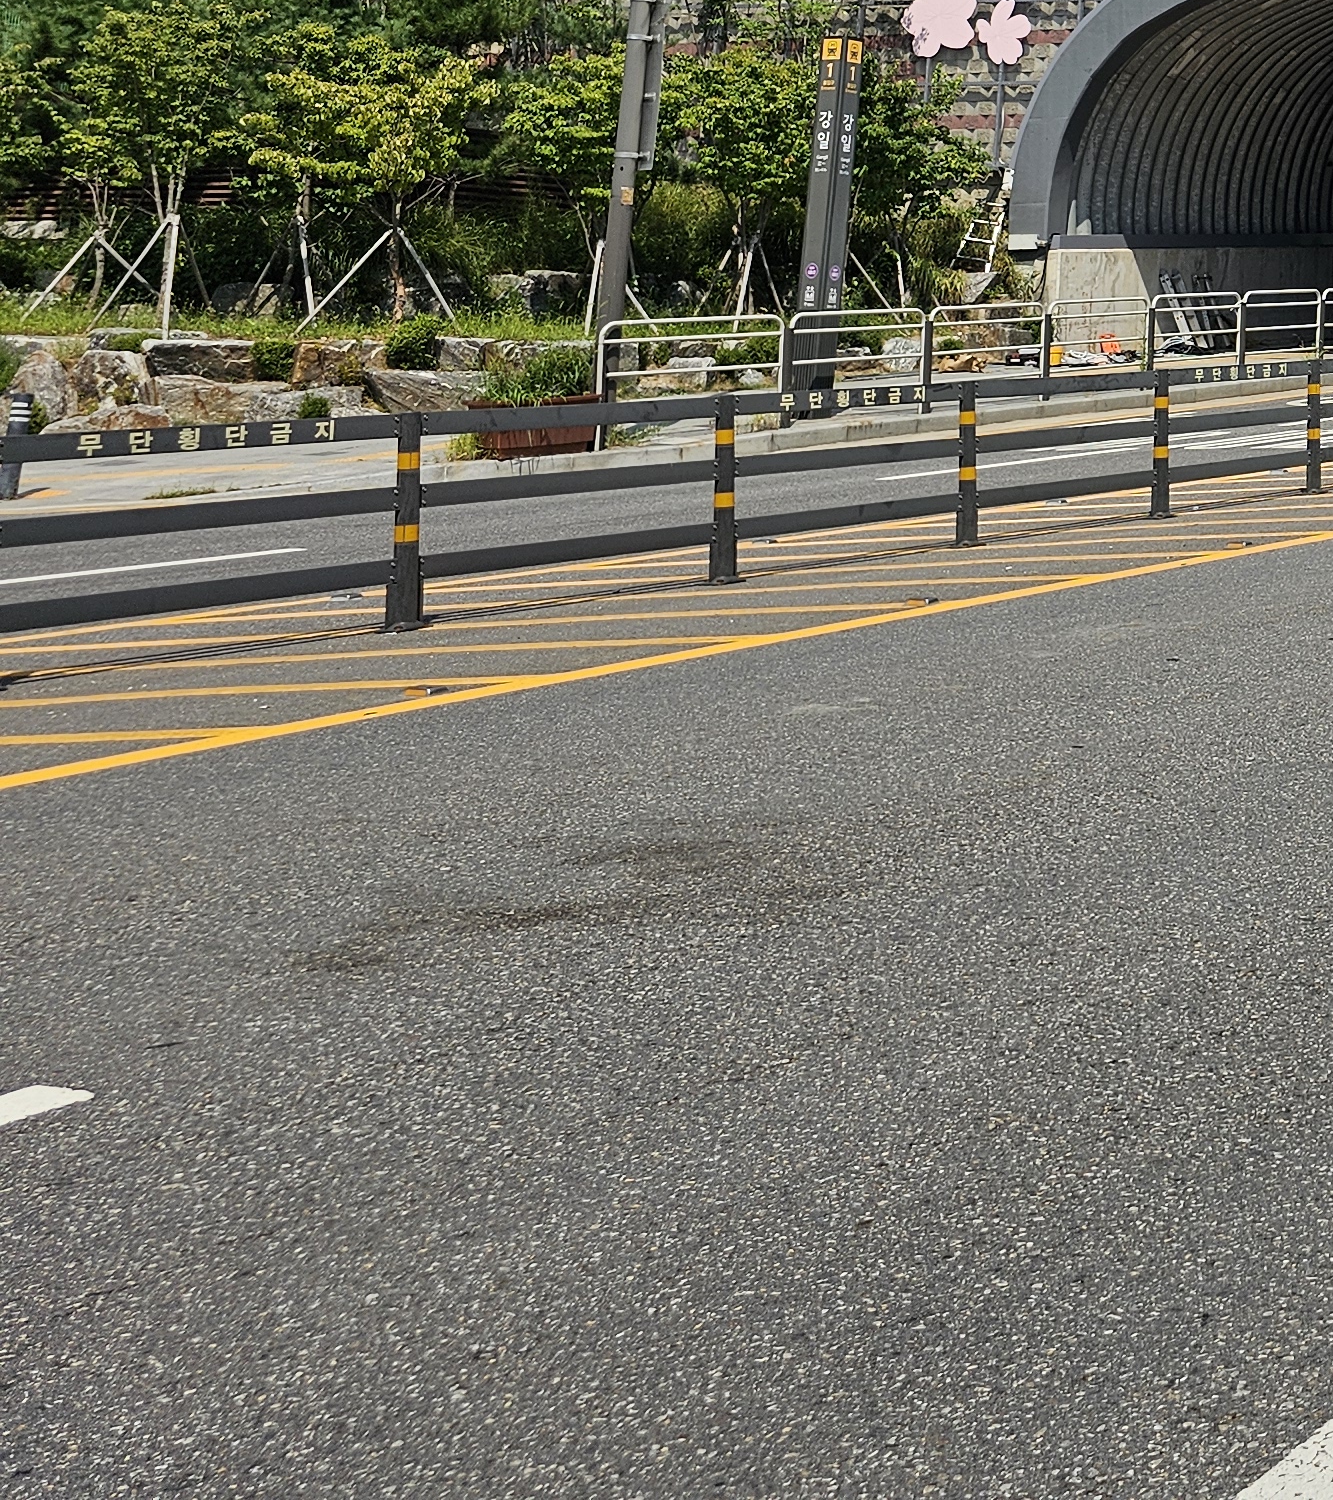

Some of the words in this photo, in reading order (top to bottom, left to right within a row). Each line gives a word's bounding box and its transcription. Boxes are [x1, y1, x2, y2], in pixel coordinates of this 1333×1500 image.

[826, 62, 834, 78] 1
[849, 66, 856, 81] 1
[817, 110, 834, 150] 강일
[840, 114, 855, 152] 강일
[1194, 363, 1288, 382] 무단횡단금지
[780, 384, 926, 409] 무단횡단금지
[77, 420, 336, 457] 무단횡단금지
